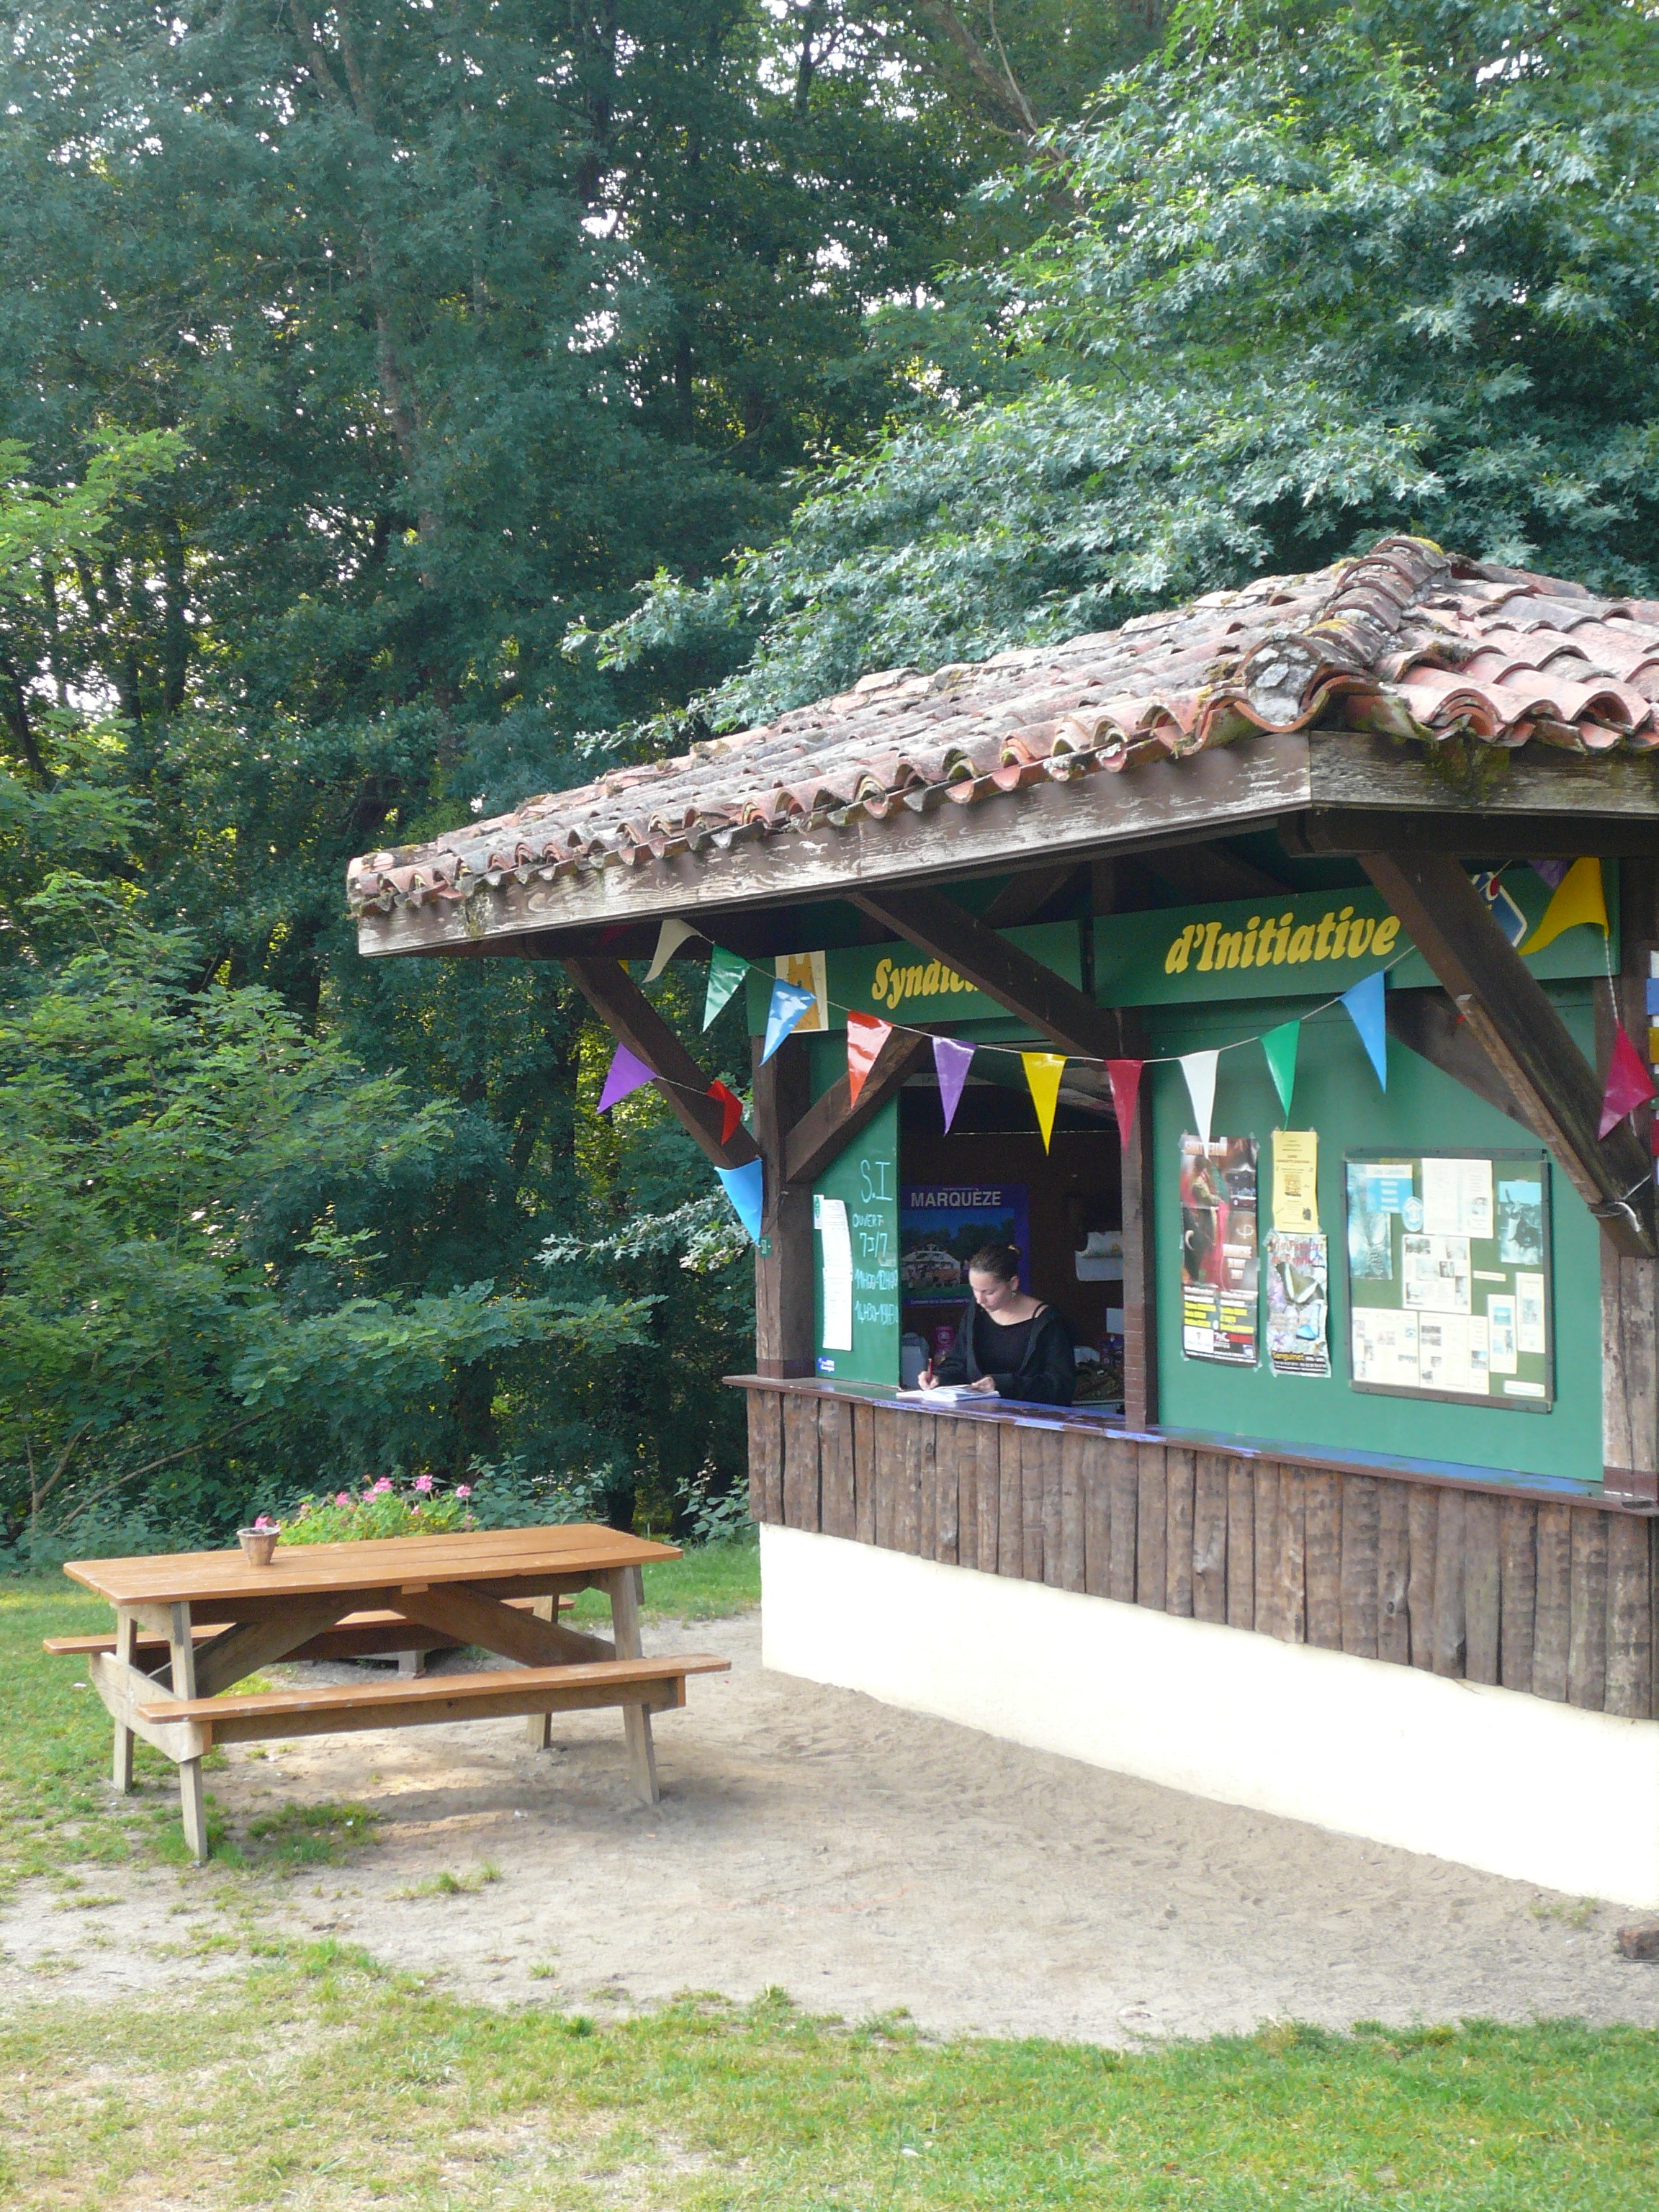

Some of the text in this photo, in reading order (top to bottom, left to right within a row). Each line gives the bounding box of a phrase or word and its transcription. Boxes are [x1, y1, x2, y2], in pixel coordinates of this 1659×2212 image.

[1164, 906, 1401, 975] d'Initiative
[871, 958, 979, 1010] Syndic
[911, 1188, 1002, 1208] MARQUÈZE
[853, 1213, 884, 1228] OUVERT
